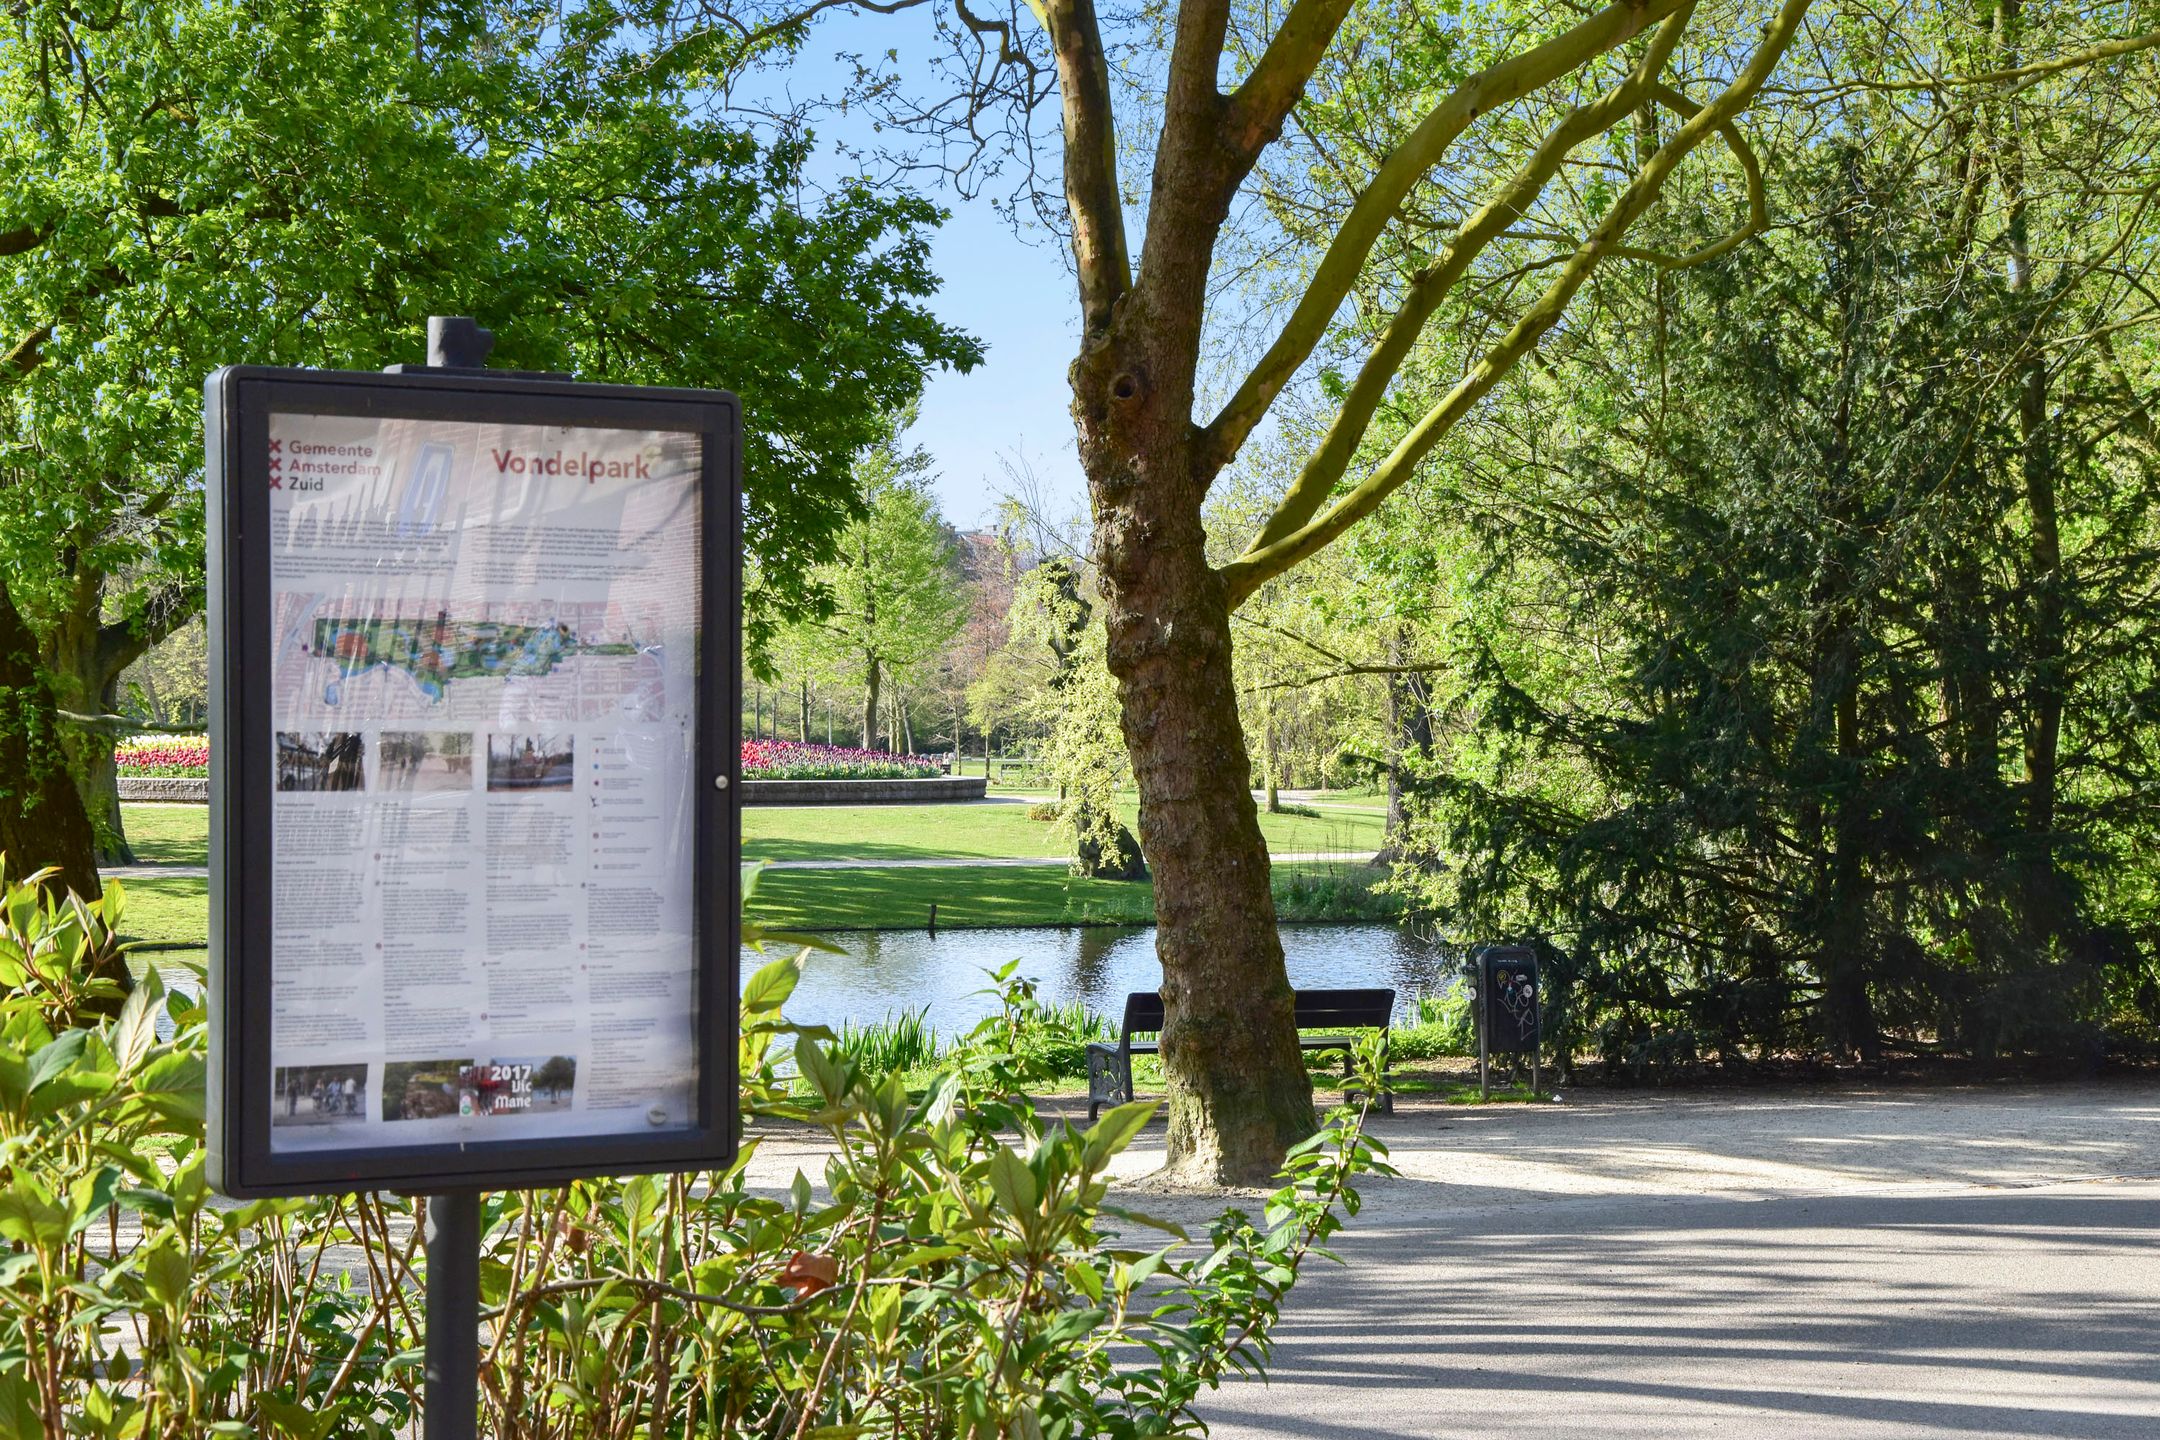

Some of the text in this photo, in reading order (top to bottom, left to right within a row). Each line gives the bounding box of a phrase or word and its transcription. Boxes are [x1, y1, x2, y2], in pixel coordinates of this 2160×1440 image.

[289, 440, 373, 457] Gemeente
[288, 459, 383, 476] Amsterdam
[491, 448, 652, 484] Vondelpark
[289, 476, 324, 491] Zuid
[490, 1065, 531, 1081] 2017
